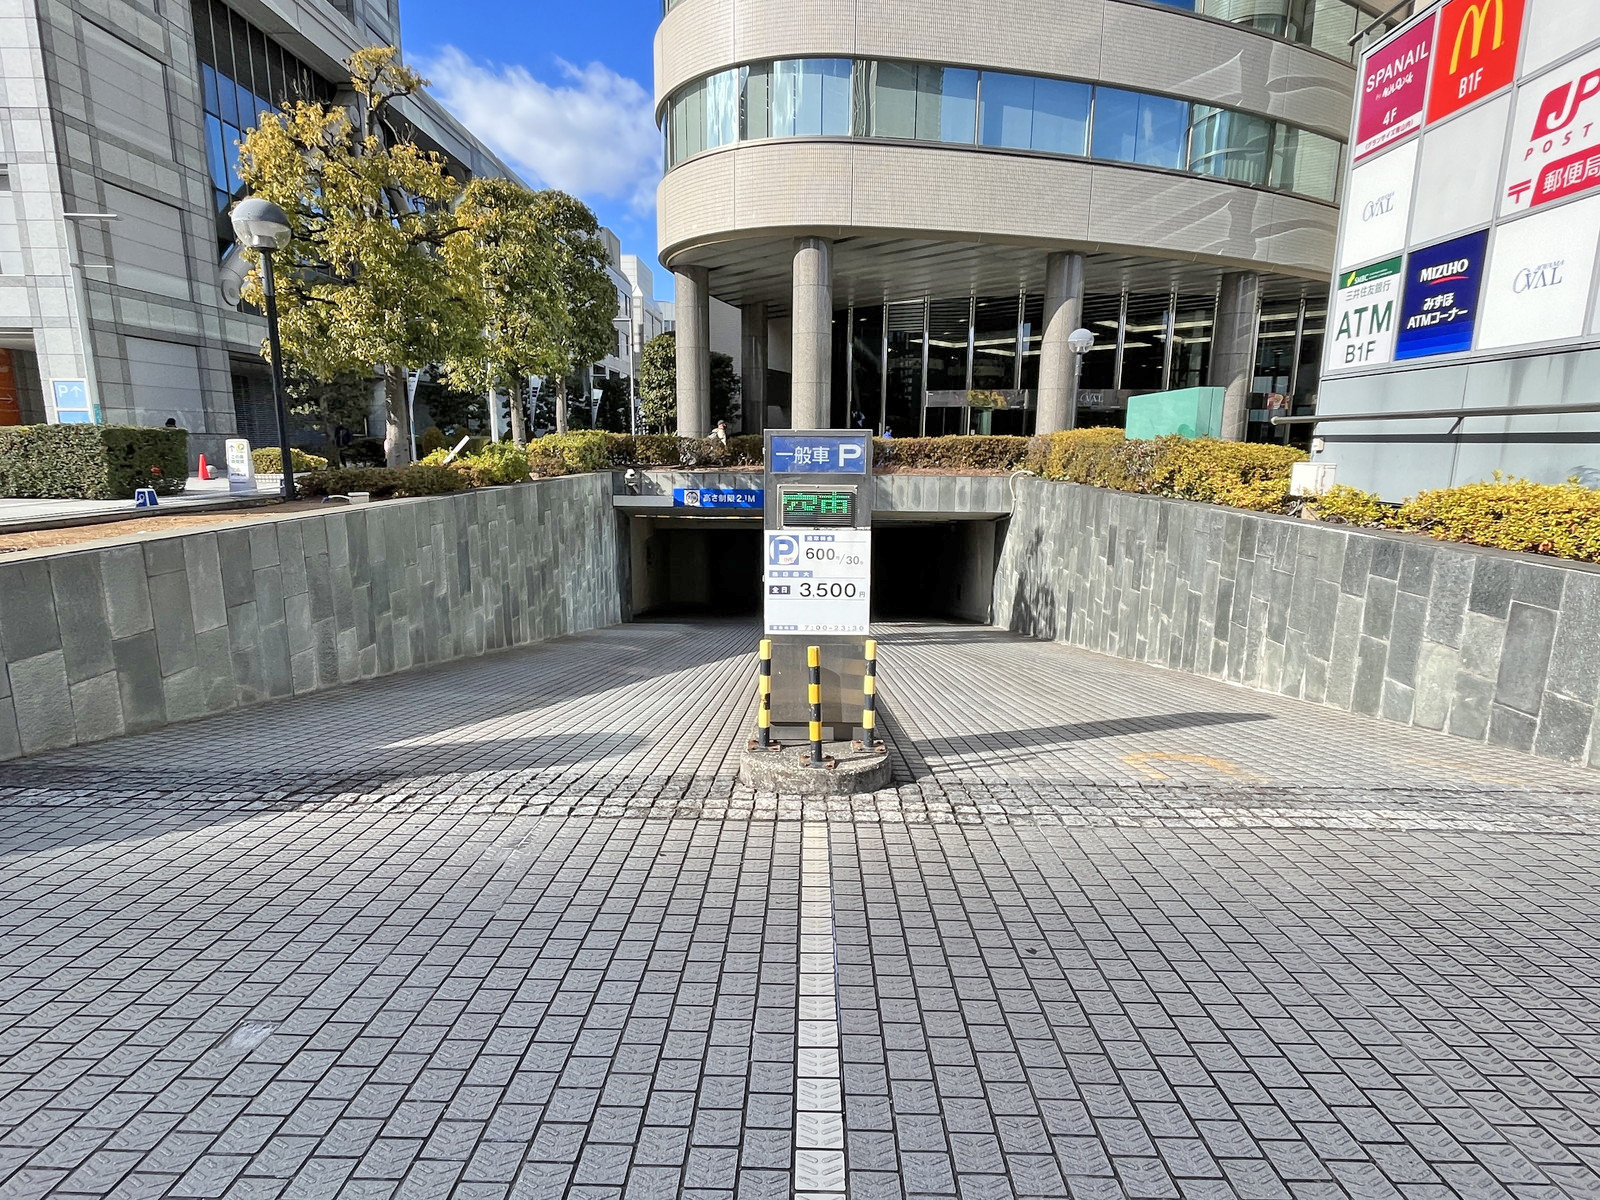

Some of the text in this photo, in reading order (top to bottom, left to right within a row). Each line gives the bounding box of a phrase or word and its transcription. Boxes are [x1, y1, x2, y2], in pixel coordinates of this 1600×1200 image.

[1366, 41, 1429, 93] SPANAIL
[1458, 67, 1484, 99] B1F
[1382, 107, 1398, 125] 4F
[1530, 67, 1600, 143] JP
[1523, 122, 1594, 161] POST
[1542, 154, 1600, 194] 郵便局
[1354, 273, 1369, 285] SMBC
[1419, 259, 1469, 283] MIZUHO
[1345, 279, 1391, 302] 三井住友銀行
[1423, 292, 1455, 311] みずほ
[1335, 300, 1394, 341] ATM
[1406, 308, 1469, 330] ATMコーナー
[1344, 340, 1377, 364] B1F
[58, 386, 69, 398] P
[775, 443, 862, 467] 一般車 P
[771, 586, 788, 594] 全日
